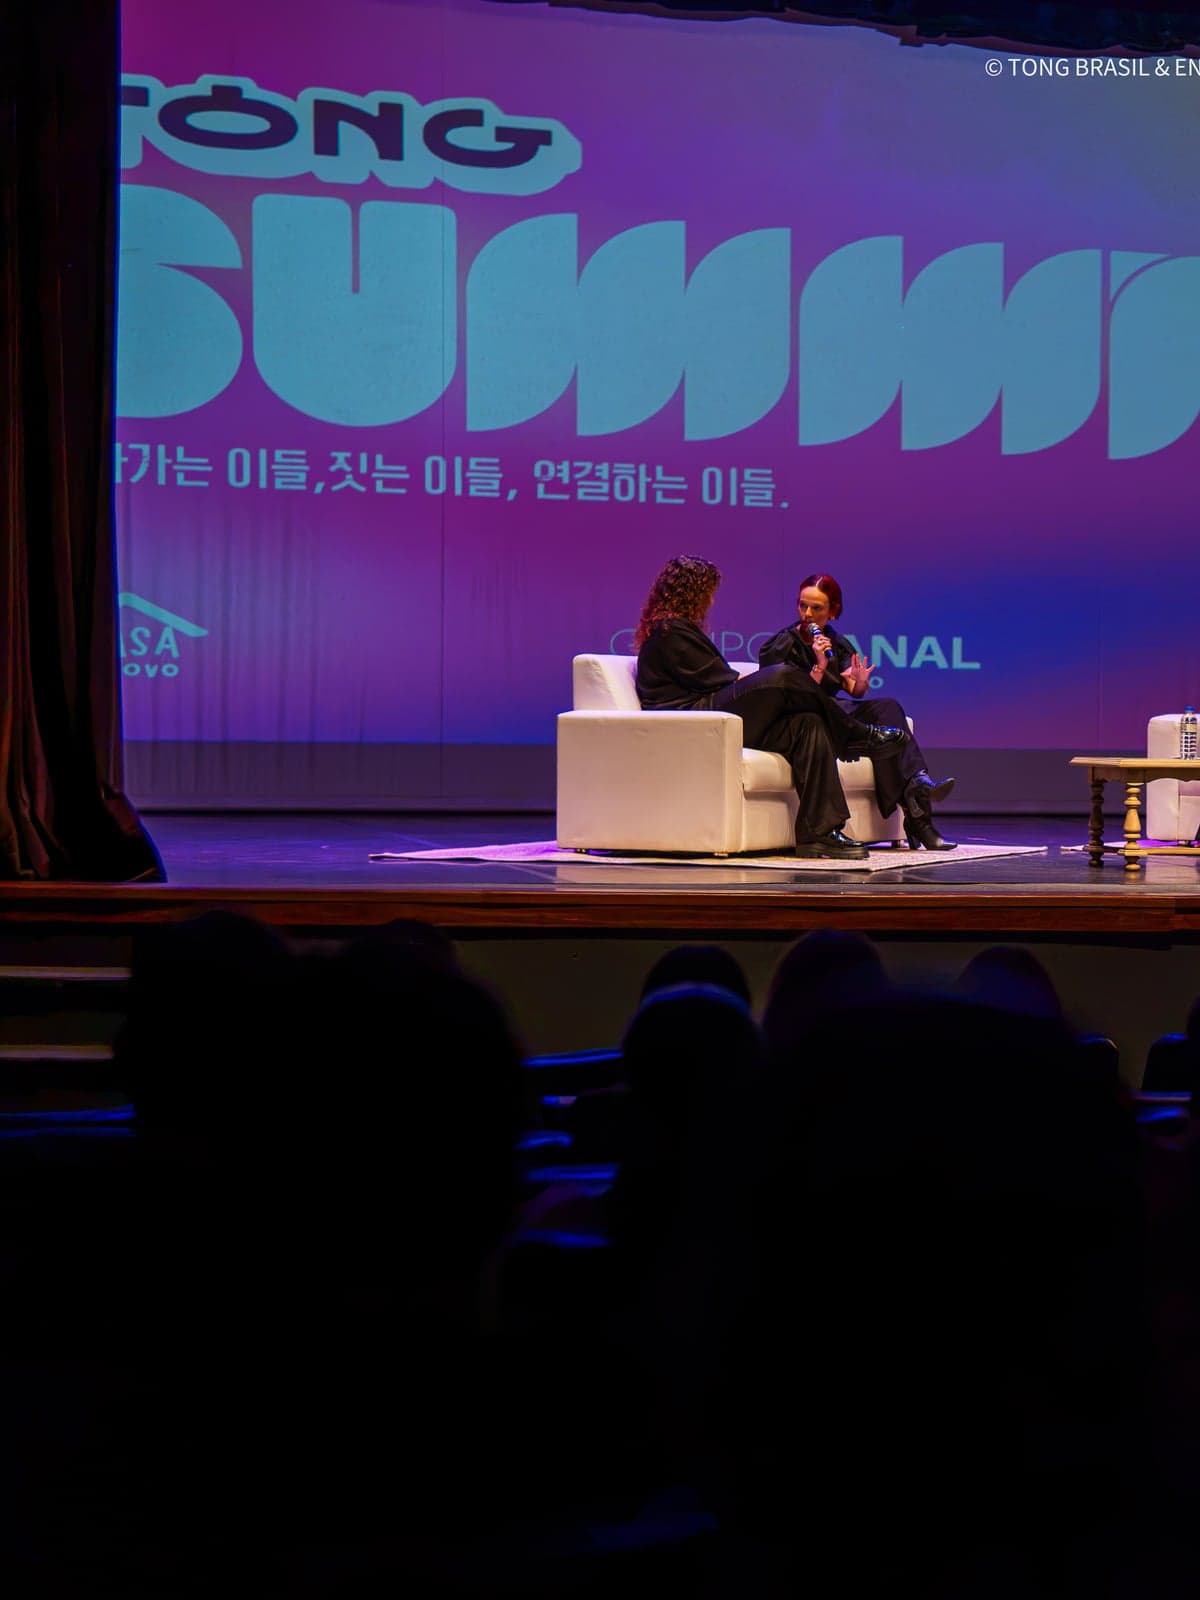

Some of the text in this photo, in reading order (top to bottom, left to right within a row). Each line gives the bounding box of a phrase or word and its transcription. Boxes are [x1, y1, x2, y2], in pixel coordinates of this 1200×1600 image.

[121, 84, 553, 169] ONG
[424, 455, 518, 501] 이들,
[534, 459, 688, 505] 연결하는
[702, 466, 789, 509] 이들.
[119, 626, 179, 658] SA
